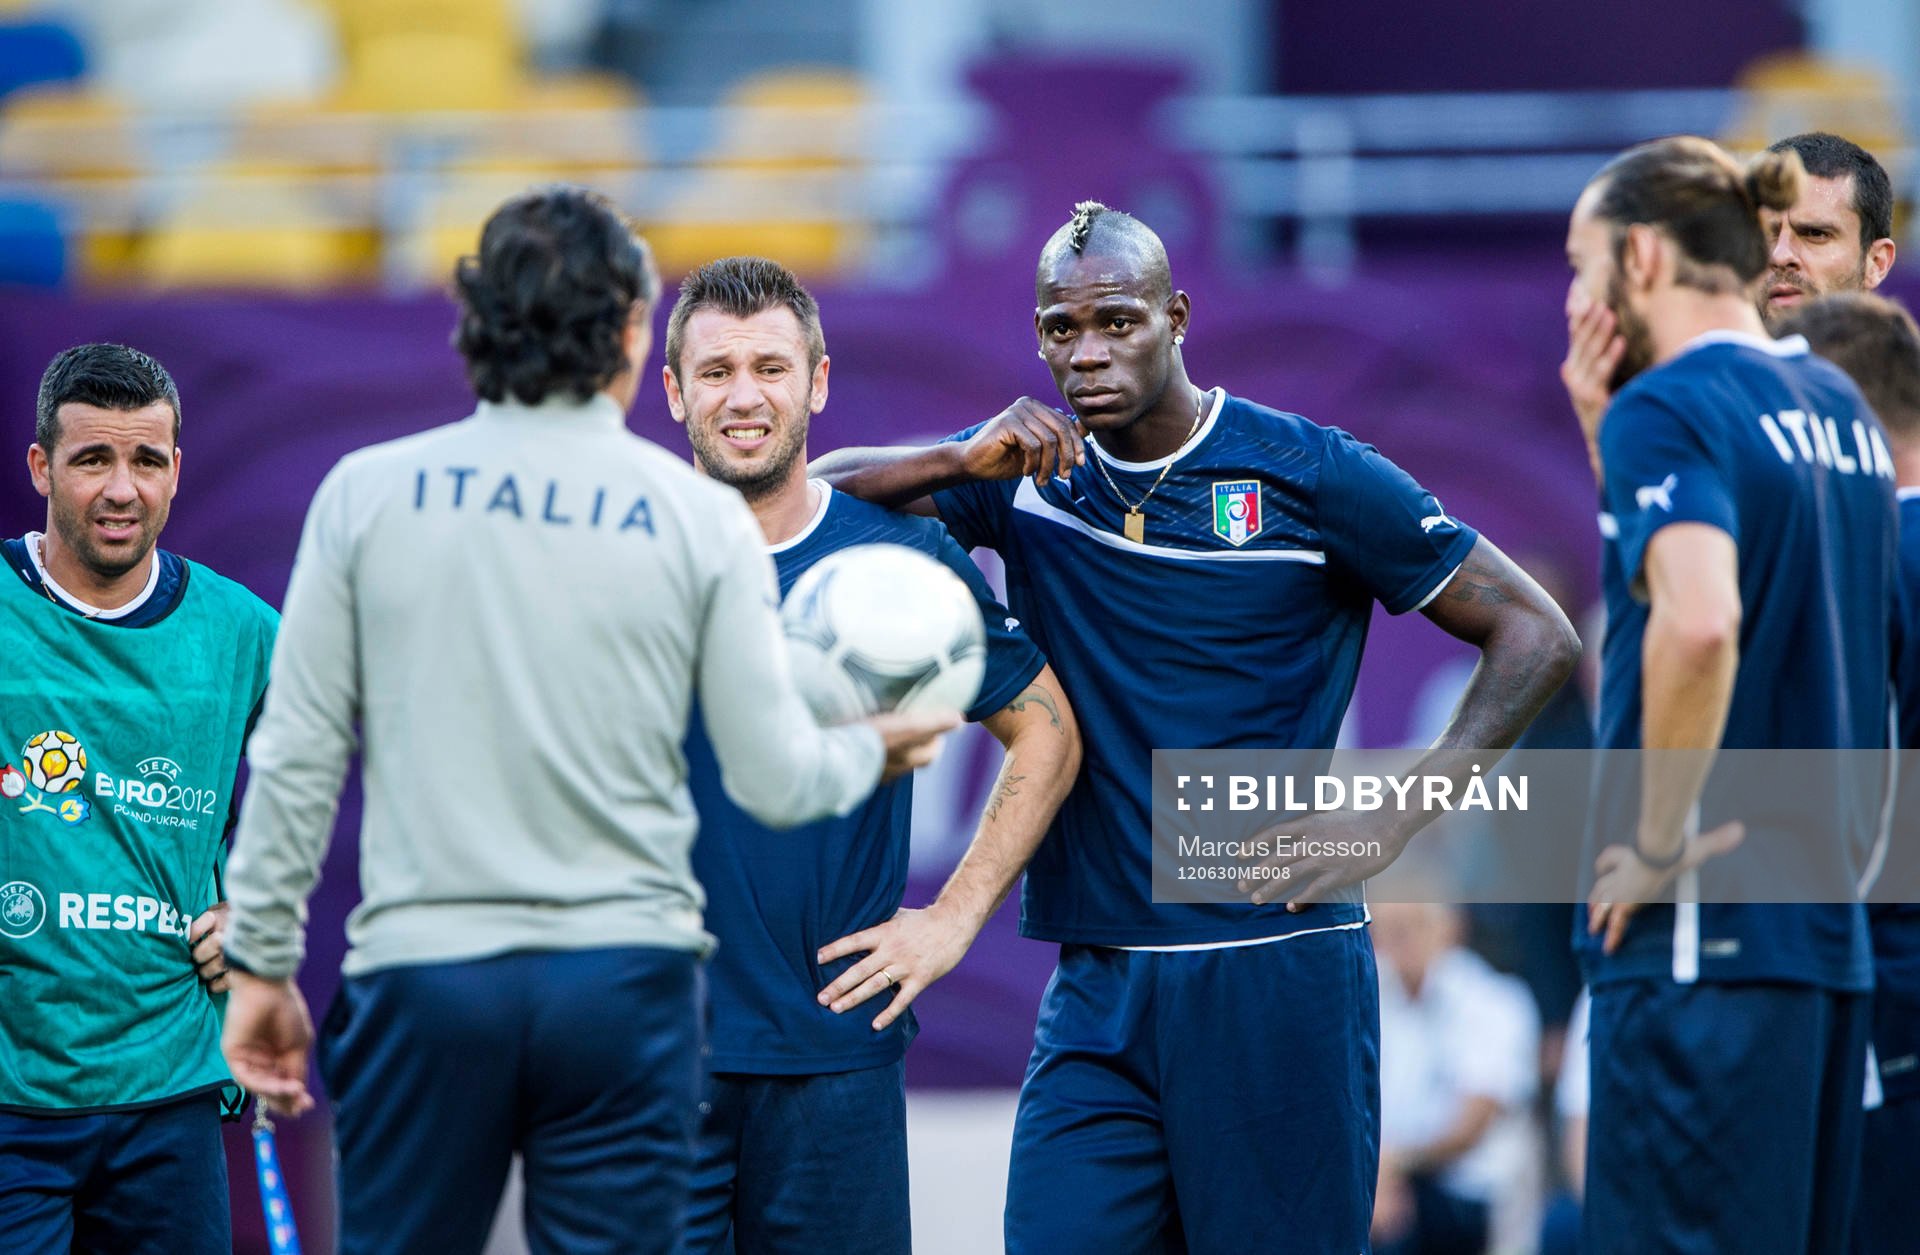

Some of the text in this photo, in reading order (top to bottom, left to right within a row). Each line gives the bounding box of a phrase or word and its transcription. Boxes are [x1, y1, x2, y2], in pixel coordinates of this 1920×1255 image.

[1759, 409, 1896, 482] ITALIA
[1220, 484, 1253, 493] ITALIA
[413, 466, 657, 537] ITALIA
[138, 761, 177, 779] UEFA
[1, 886, 33, 898] UEFA
